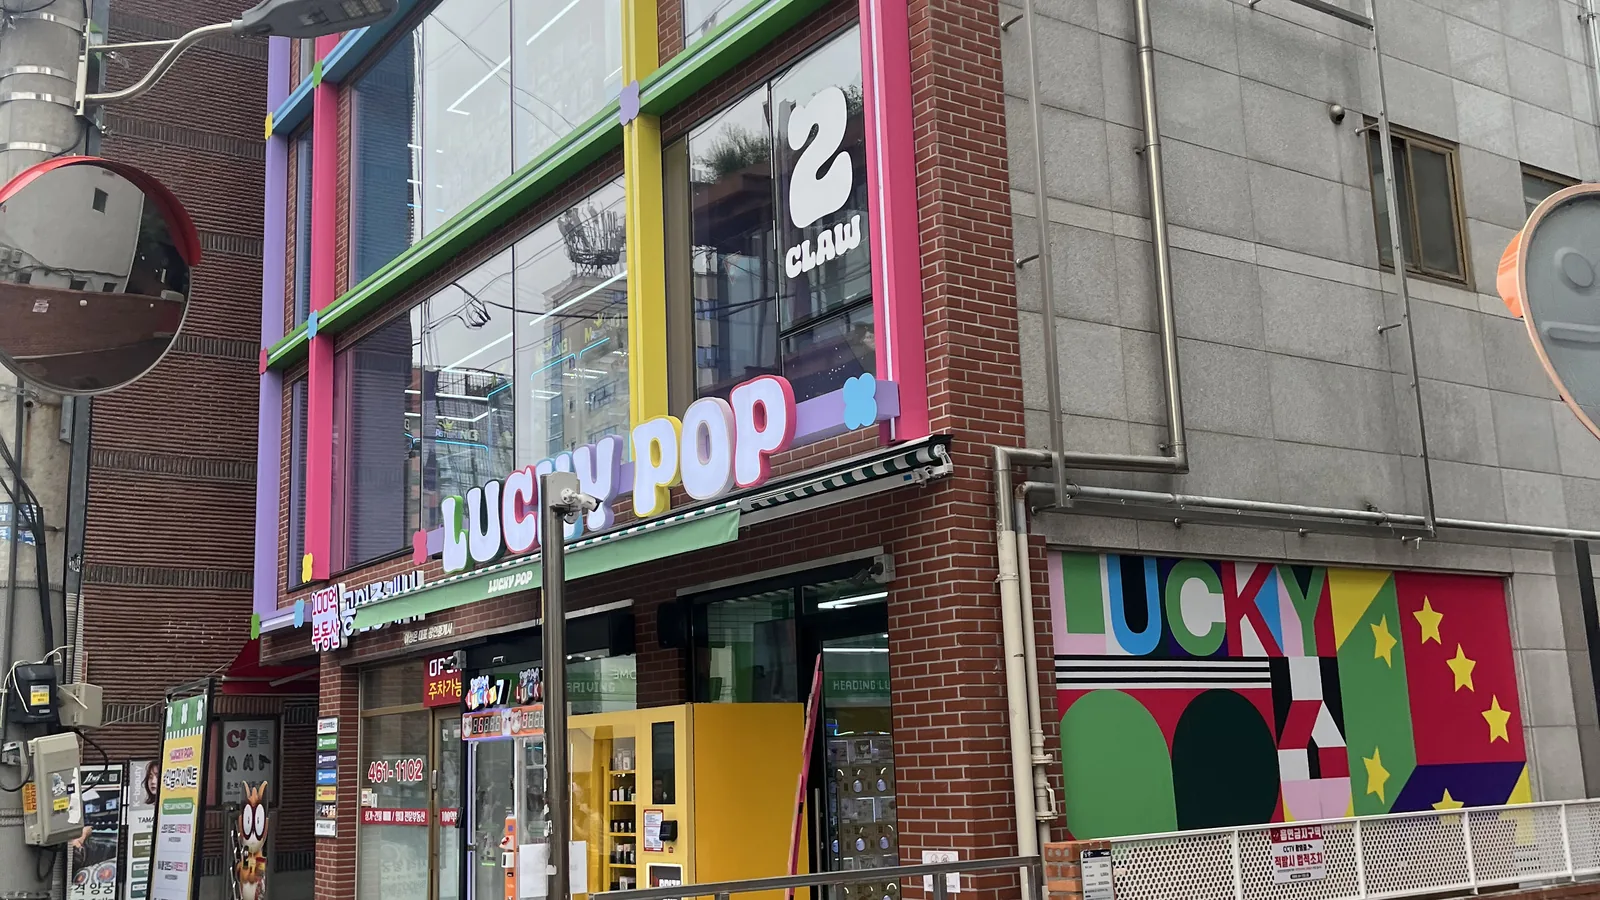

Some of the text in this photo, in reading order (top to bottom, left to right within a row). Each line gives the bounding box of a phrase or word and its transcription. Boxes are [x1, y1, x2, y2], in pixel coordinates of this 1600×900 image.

[788, 86, 853, 228] 2
[785, 215, 861, 279] CLAW
[632, 374, 797, 517] POP
[488, 571, 533, 593] LUCKY POP
[312, 584, 338, 615] 100억
[1047, 551, 1327, 657] LUCKY
[312, 619, 340, 651] 부동산
[429, 656, 462, 676] OPE
[428, 678, 462, 700] 주차가능
[467, 679, 504, 710] LUCKY 7
[833, 680, 876, 690] HEADING
[368, 757, 423, 783] 461-1102
[132, 765, 144, 807] K-beauty
[1274, 852, 1323, 868] 적발시 법적조치
[1283, 845, 1295, 853] CCTV
[72, 882, 115, 896] 격 양궁
